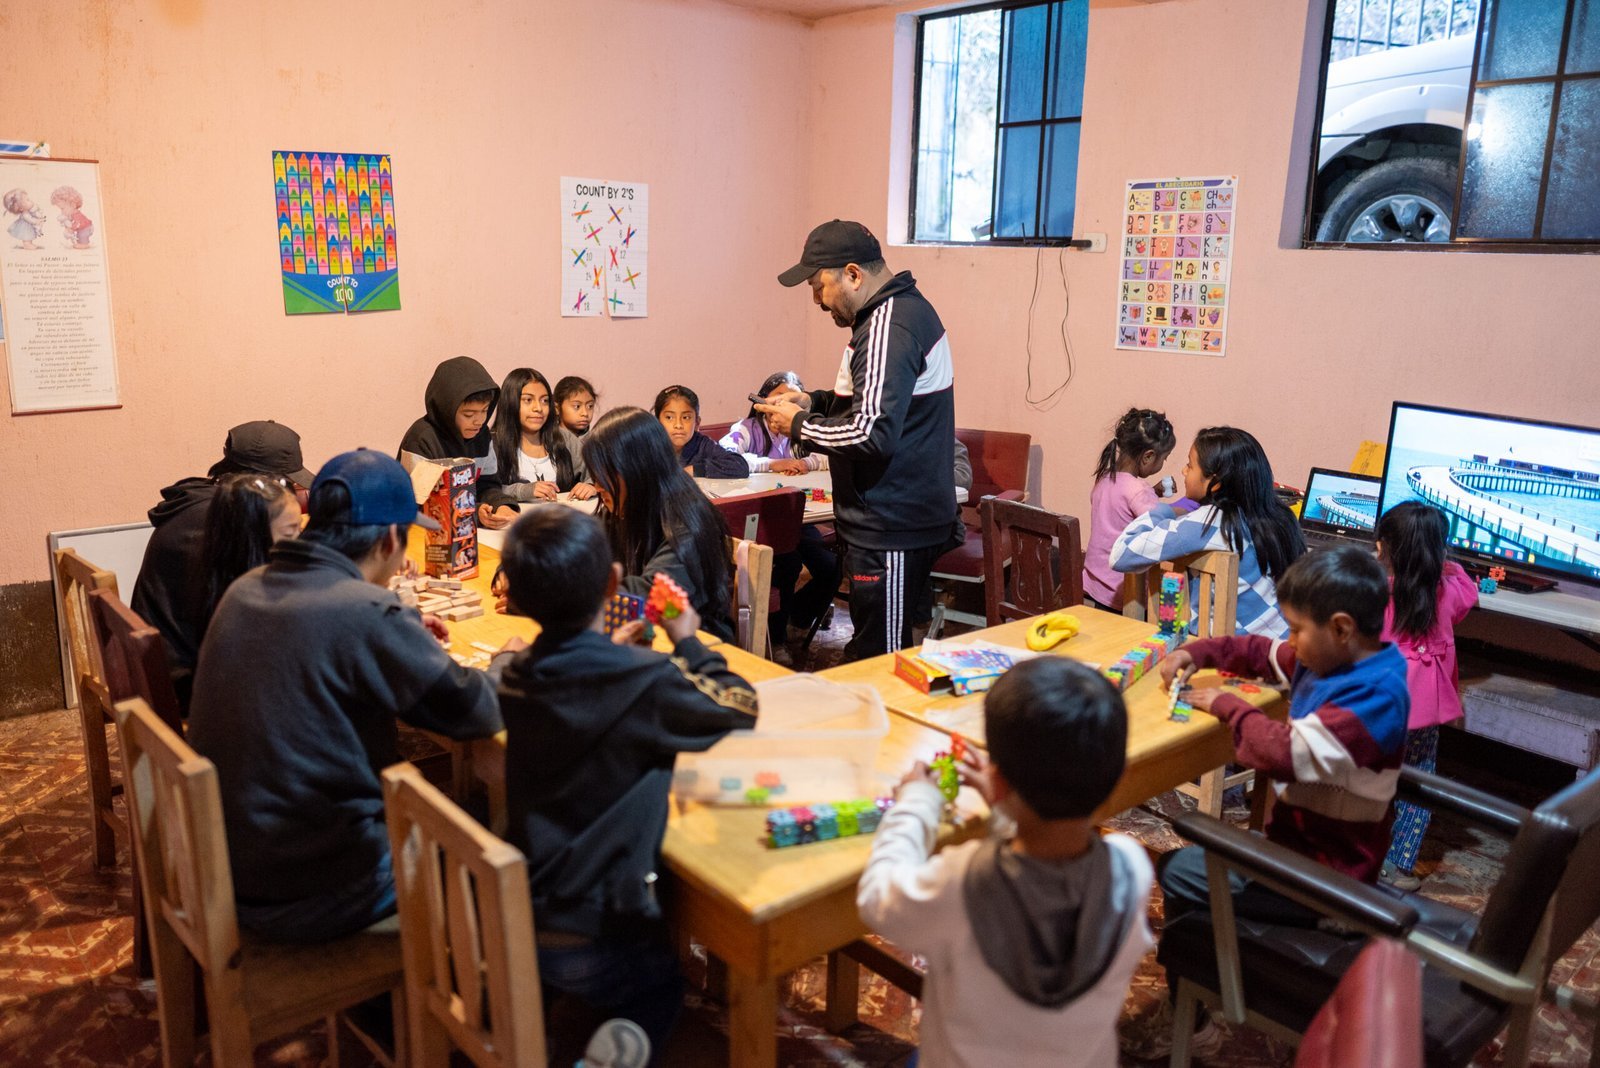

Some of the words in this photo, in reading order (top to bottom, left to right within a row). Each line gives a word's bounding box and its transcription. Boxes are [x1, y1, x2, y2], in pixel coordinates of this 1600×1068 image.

[576, 184, 605, 197] COUNT
[608, 187, 618, 199] BY
[1155, 191, 1160, 201] B
[1181, 191, 1186, 201] C
[1207, 190, 1218, 199] CH
[1130, 193, 1135, 202] A
[1155, 202, 1160, 210] b
[1206, 200, 1216, 209] ch
[1128, 216, 1134, 225] D
[1154, 215, 1158, 224] E
[1179, 214, 1184, 224] F
[1206, 214, 1212, 223] G
[1128, 225, 1133, 234] d
[1206, 224, 1211, 233] g
[1127, 237, 1133, 246] H
[1151, 238, 1156, 247] I
[1177, 237, 1184, 247] J
[1204, 237, 1210, 247] K
[1126, 248, 1131, 256] h
[1125, 260, 1130, 269] L
[1176, 261, 1182, 270] M
[1203, 261, 1208, 270] N
[350, 278, 358, 288] TO
[1148, 283, 1154, 292] O
[1174, 284, 1179, 293] P
[1200, 284, 1207, 294] Q
[1201, 295, 1206, 304] q
[1122, 305, 1127, 313] R
[1147, 306, 1152, 315] S
[1172, 307, 1177, 316] T
[1200, 308, 1206, 317] U
[1121, 327, 1126, 335] V
[1140, 328, 1148, 337] W
[1161, 329, 1166, 338] X
[1182, 330, 1186, 339] Y
[1203, 332, 1210, 341] Z
